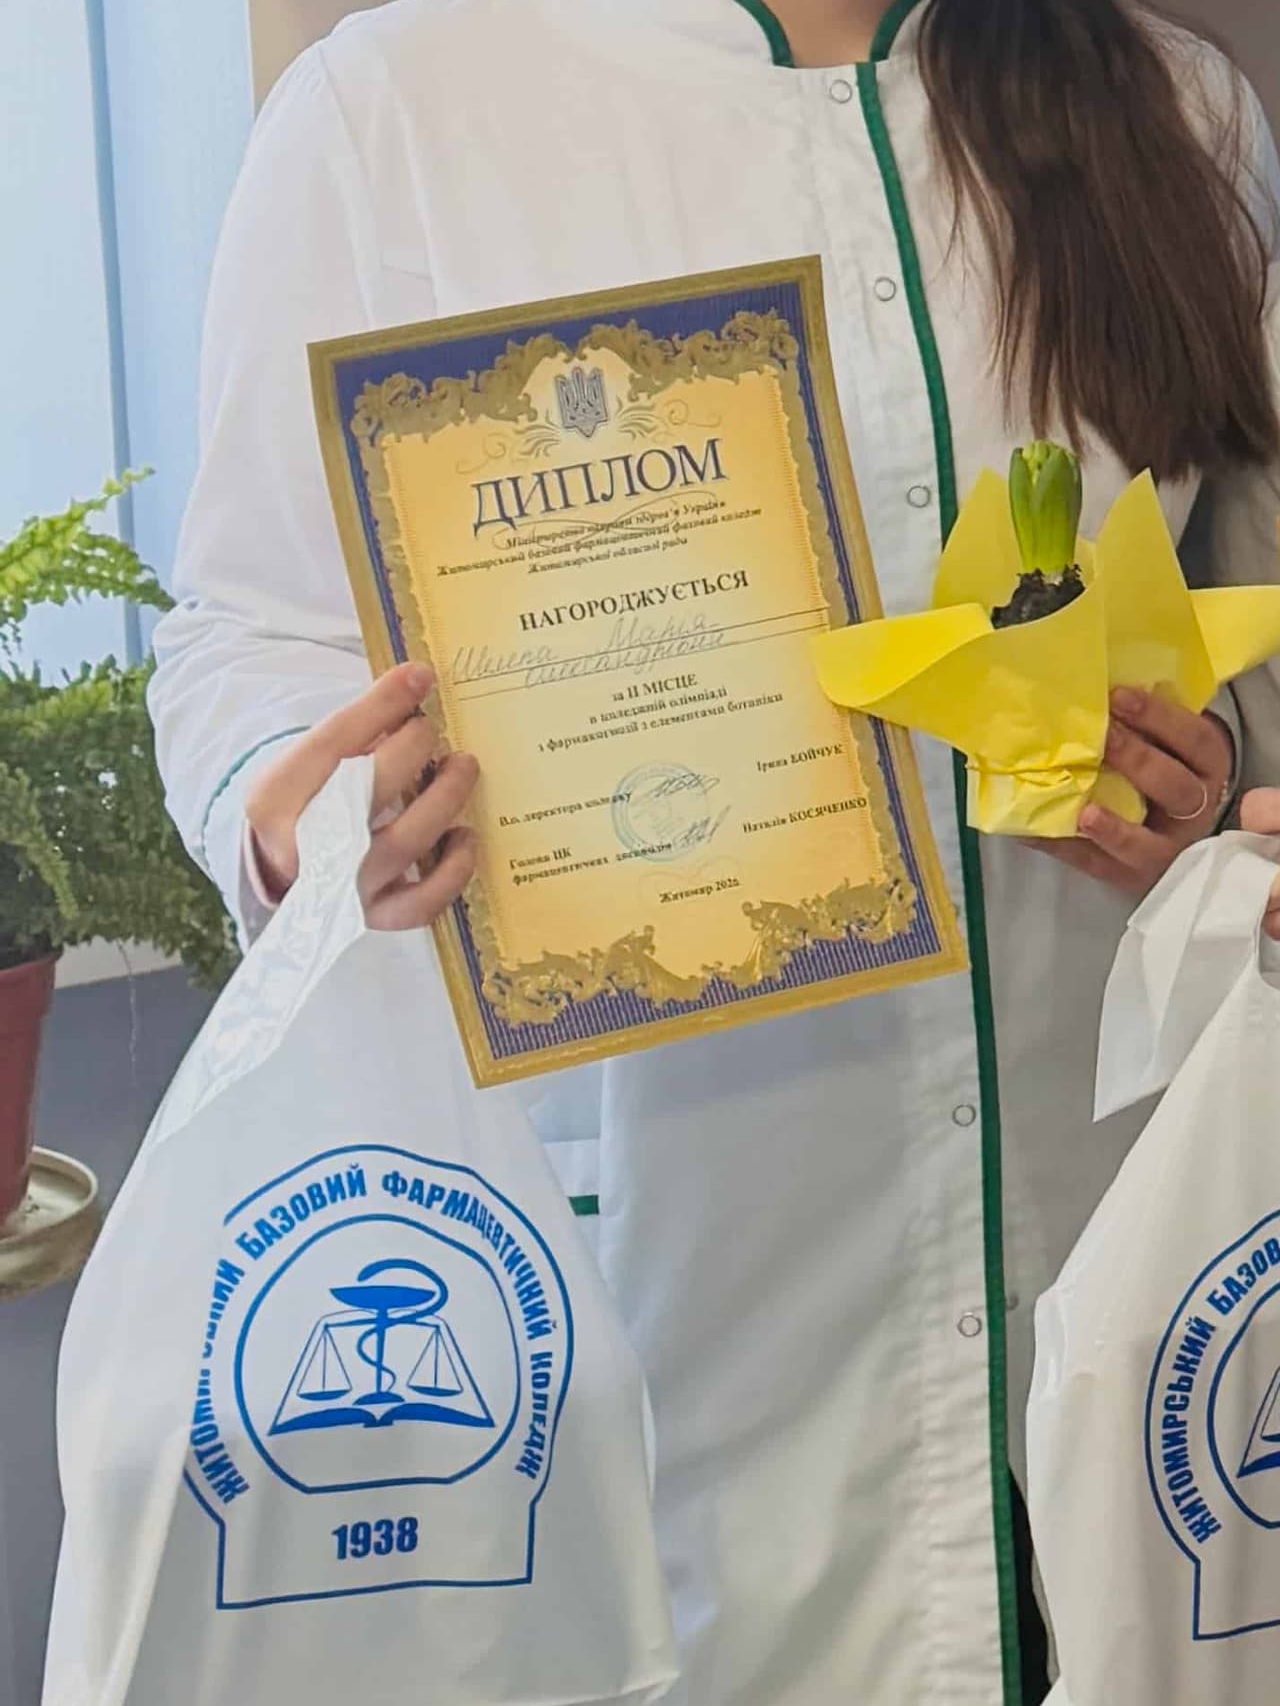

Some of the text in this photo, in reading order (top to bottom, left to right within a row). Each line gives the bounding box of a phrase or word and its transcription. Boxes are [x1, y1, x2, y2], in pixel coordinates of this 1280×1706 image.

[471, 438, 731, 540] ДИПЛОМ
[519, 569, 750, 632] НАГОРОДЖУЄТЬСЯ
[642, 673, 699, 697] МІСЦЕ
[236, 1161, 368, 1262] БАЗОВИЙ
[515, 1351, 553, 1480] КОЛЕДЖ
[1161, 1315, 1222, 1544] ЖИТОМИРСЬКИЙ
[331, 1516, 419, 1560] 1938
